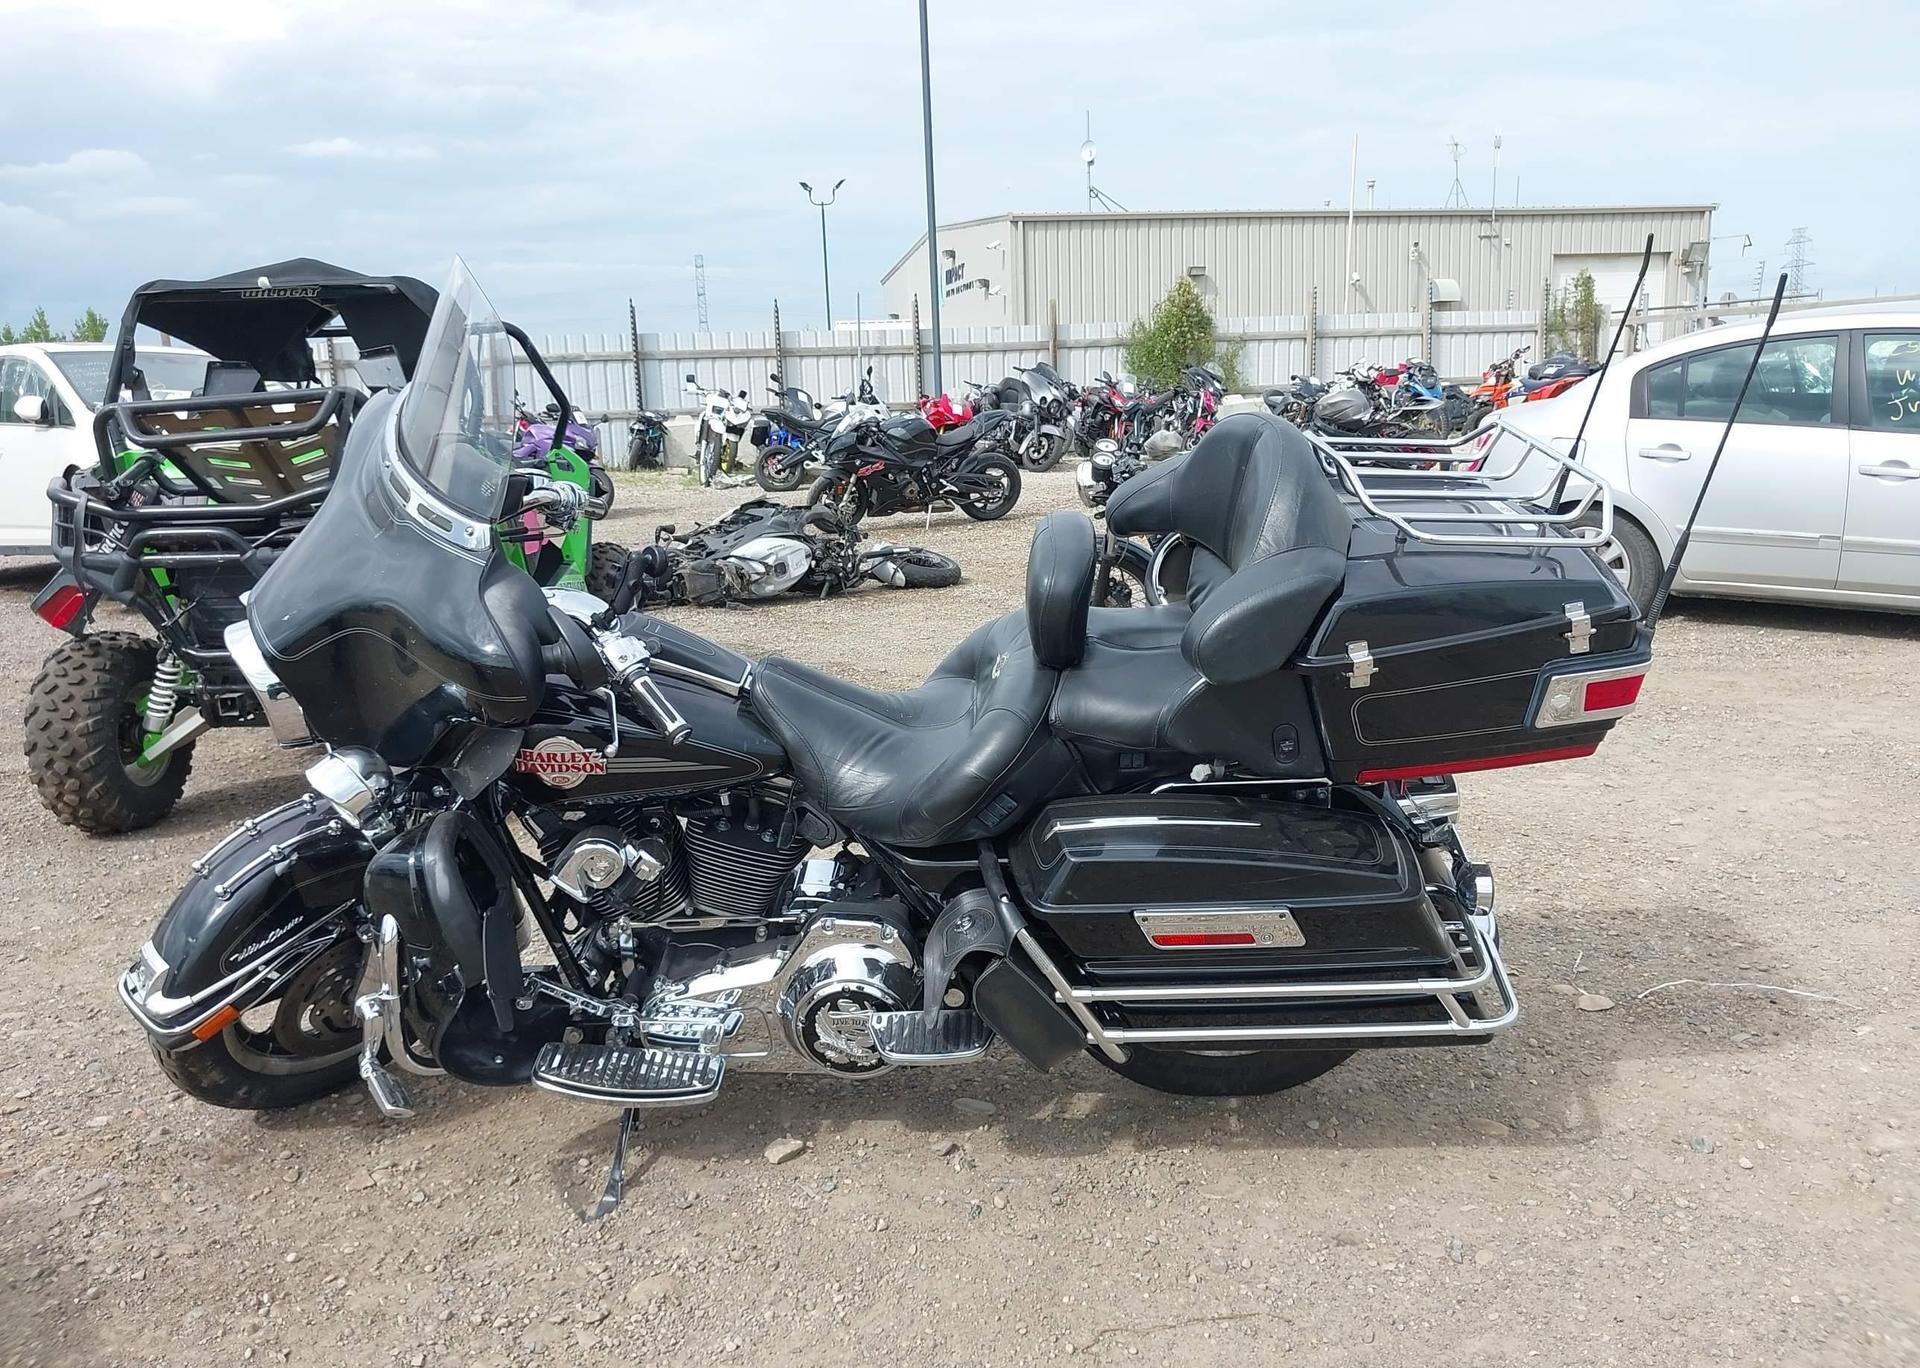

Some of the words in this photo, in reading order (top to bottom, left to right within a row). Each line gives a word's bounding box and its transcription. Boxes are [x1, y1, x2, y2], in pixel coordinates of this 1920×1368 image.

[241, 286, 321, 298] WILDCAT
[516, 761, 605, 773] DAVIDSON
[832, 1018, 850, 1026] LIVE
[851, 1018, 861, 1026] TO
